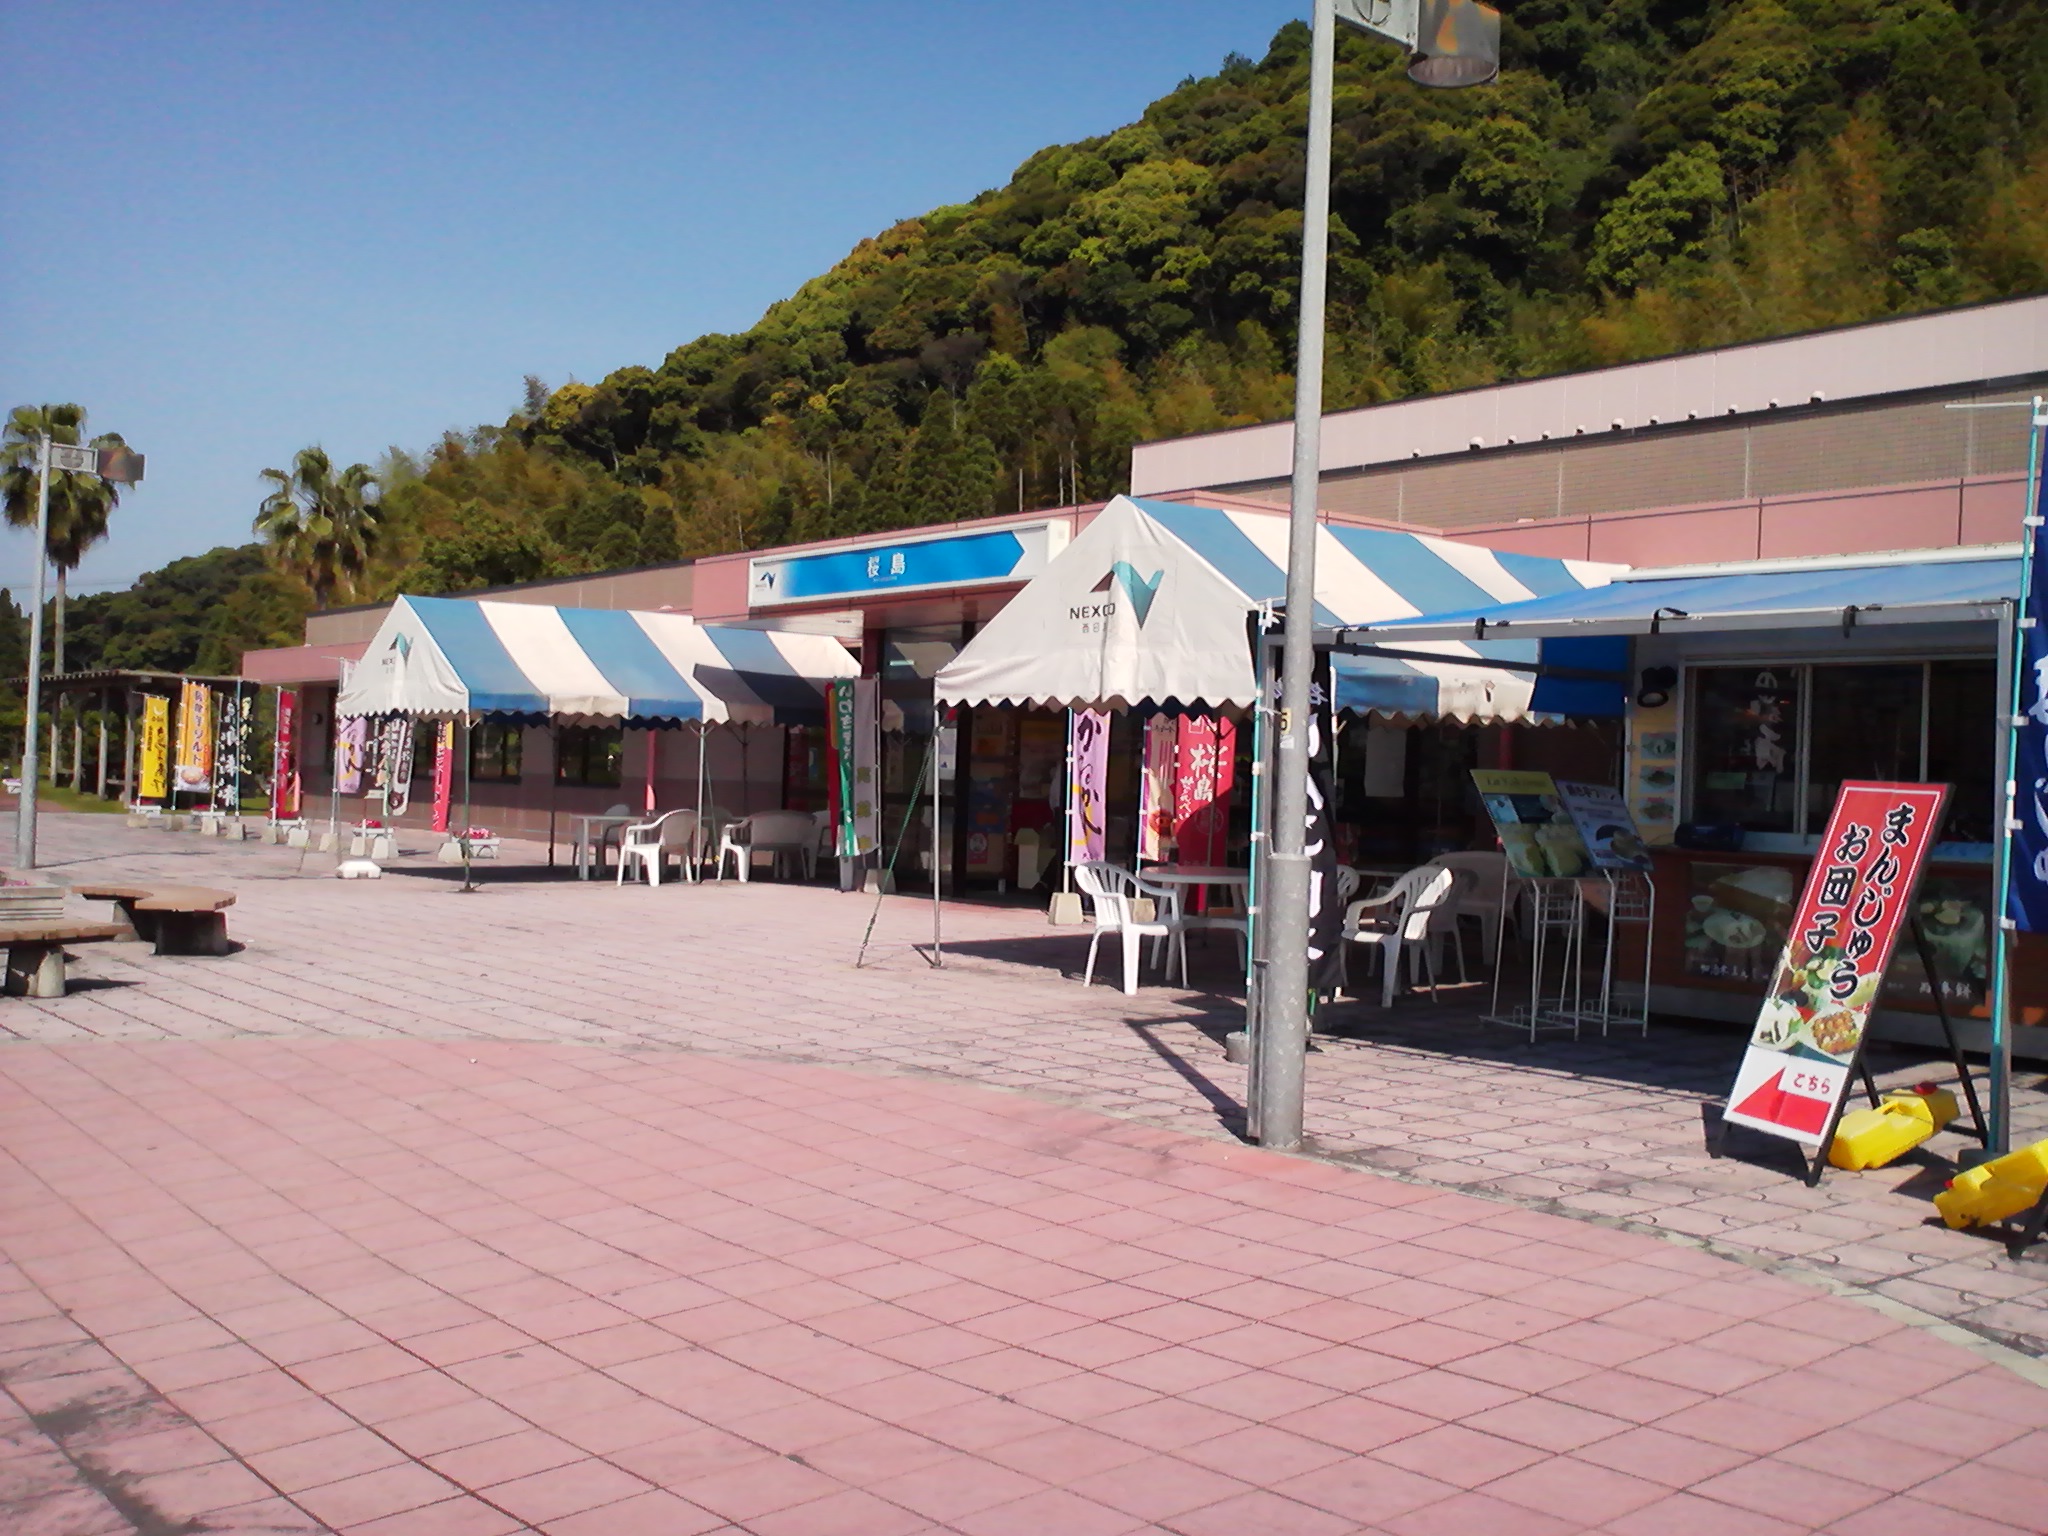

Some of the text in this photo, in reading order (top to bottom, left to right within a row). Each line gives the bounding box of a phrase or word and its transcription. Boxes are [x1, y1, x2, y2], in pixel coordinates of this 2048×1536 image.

[867, 552, 906, 578] 桜島
[1805, 820, 1873, 955] お団子
[1793, 1073, 1831, 1095] こちら
